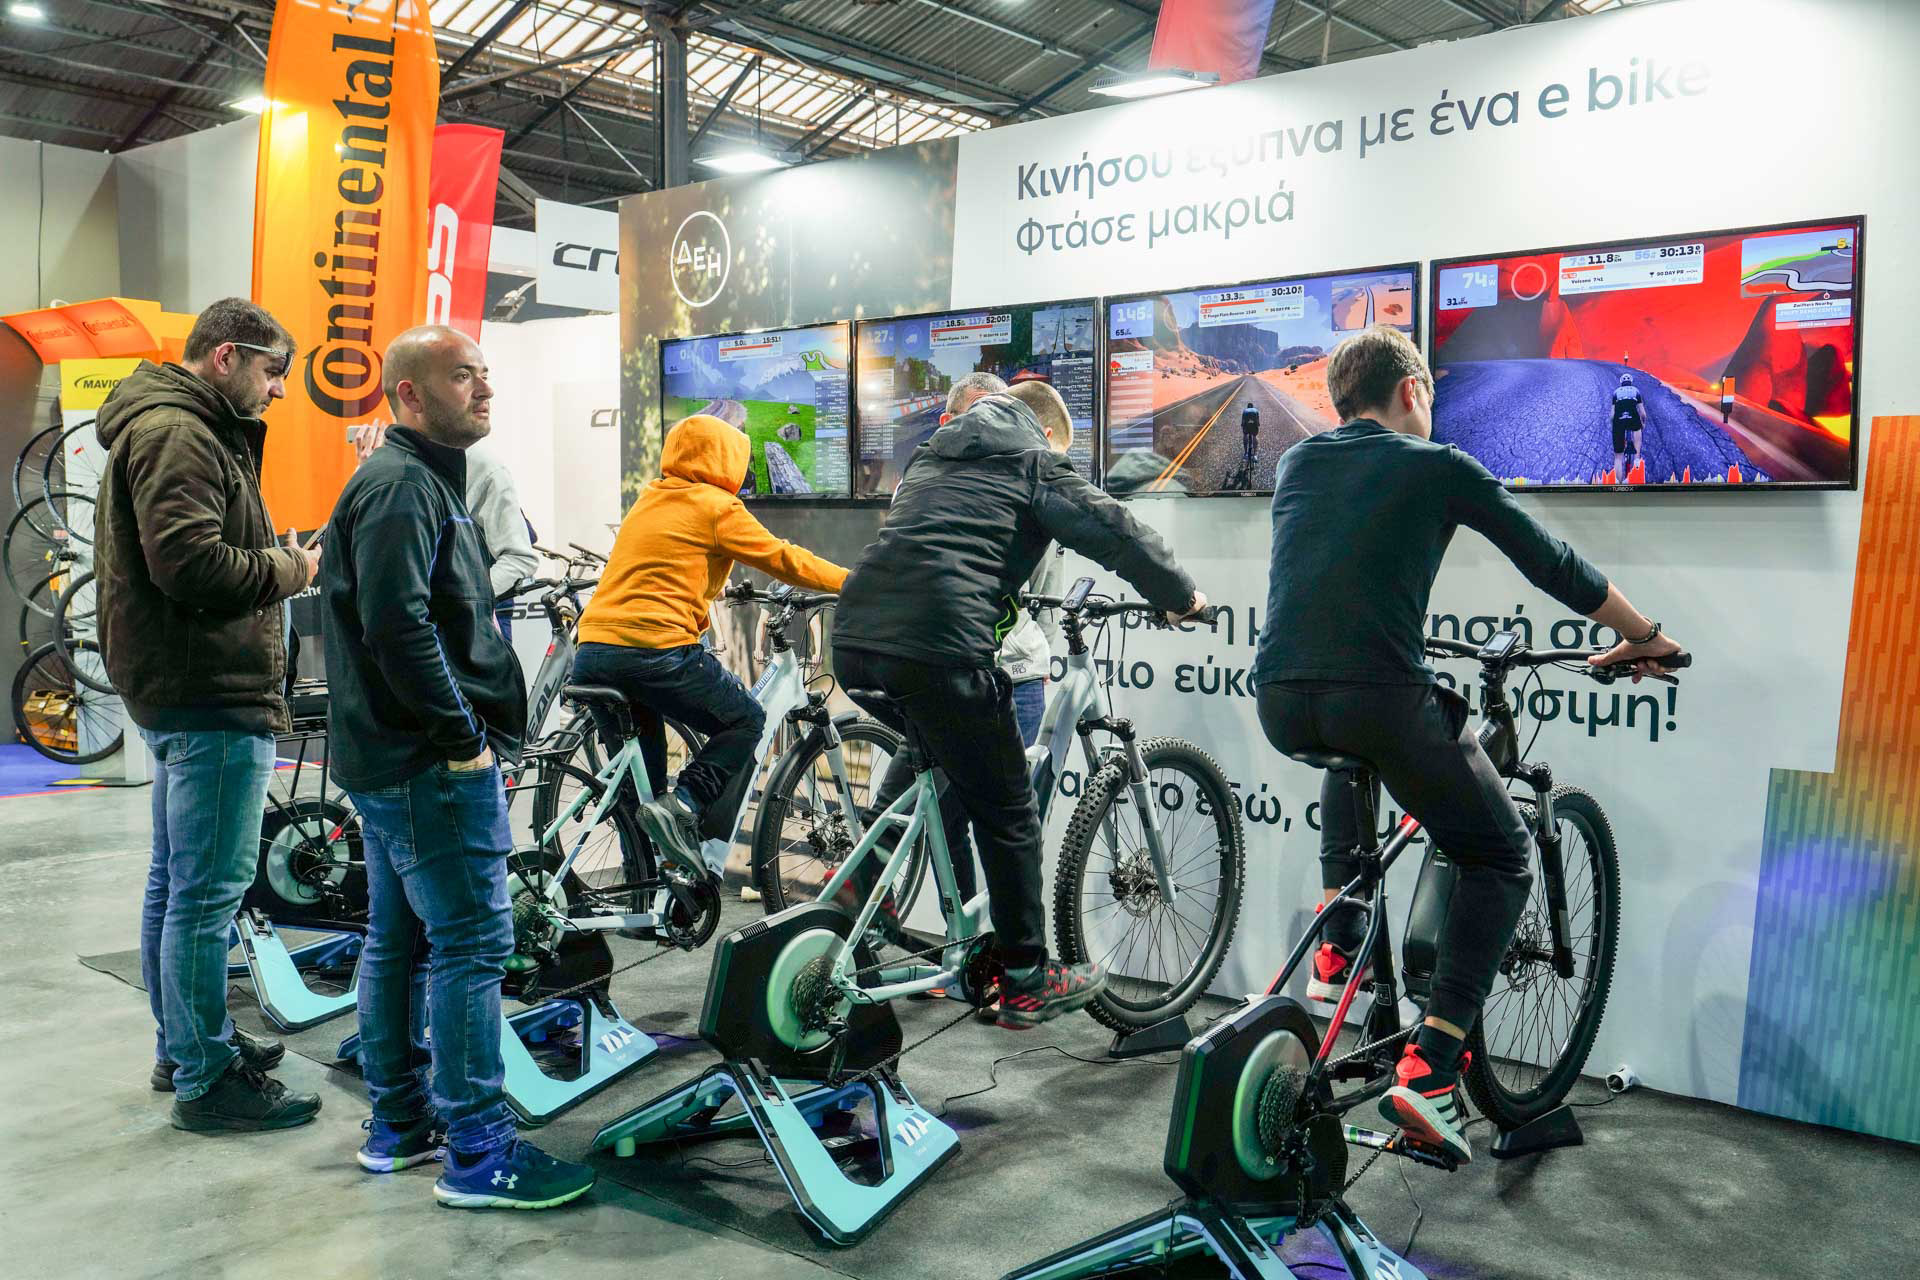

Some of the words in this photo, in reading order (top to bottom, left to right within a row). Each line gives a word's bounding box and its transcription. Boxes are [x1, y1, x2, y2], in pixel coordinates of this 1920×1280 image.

[1017, 152, 1173, 200] Κινήσου
[1360, 108, 1415, 159] με
[1429, 88, 1520, 136] ένα
[1537, 82, 1570, 119] e
[1588, 56, 1712, 113] bike
[304, 33, 396, 418] Continental
[1016, 210, 1137, 256] Φτάσε
[1148, 179, 1295, 249] μακριά
[676, 239, 721, 278] ΔΕΗ
[1588, 253, 1614, 265] 11.8
[1660, 245, 1694, 258] 30:13
[1220, 292, 1239, 302] 13.3
[1271, 286, 1298, 296] 30:10
[1462, 271, 1487, 289] 74
[986, 315, 1006, 324] 52:00
